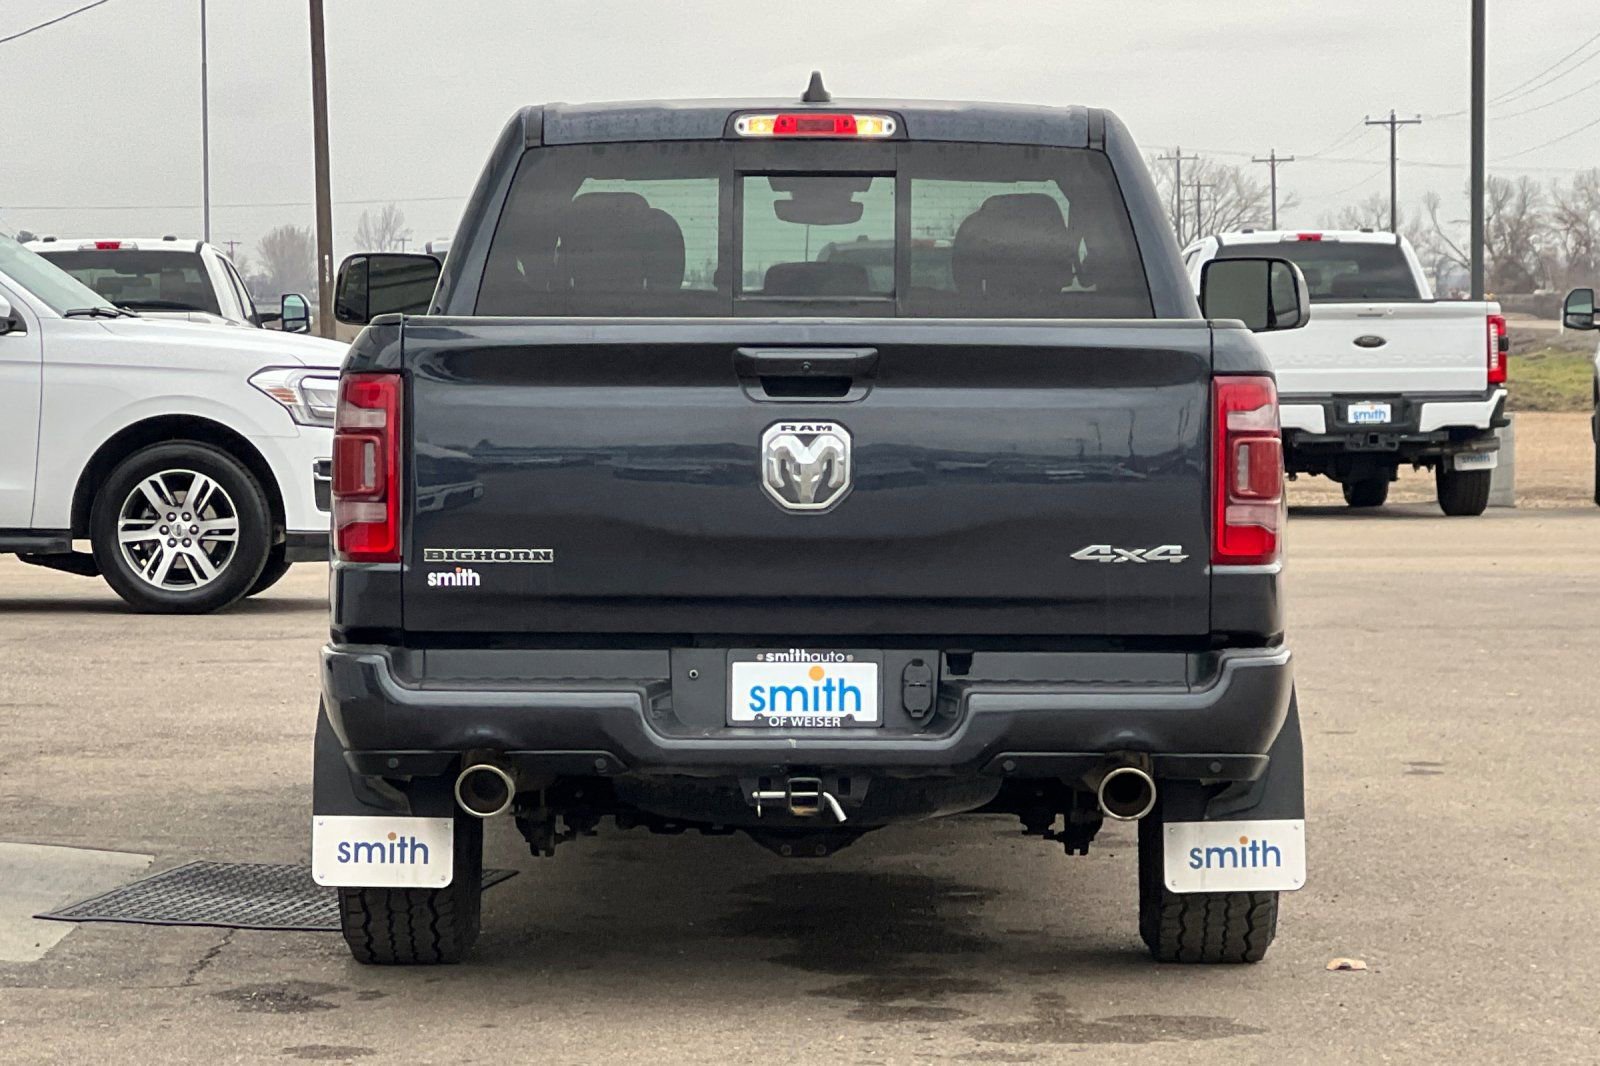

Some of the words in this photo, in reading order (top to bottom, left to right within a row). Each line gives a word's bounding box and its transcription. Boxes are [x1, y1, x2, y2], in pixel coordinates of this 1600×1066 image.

[1353, 404, 1386, 420] smith
[780, 424, 833, 432] RAM
[423, 548, 554, 563] BIGHORN
[427, 566, 481, 587] smith
[765, 648, 845, 662] smithauto
[749, 665, 862, 712] smith
[768, 716, 788, 727] OF
[790, 716, 841, 728] WEISER
[337, 831, 429, 865] smith
[1189, 835, 1282, 869] smith
